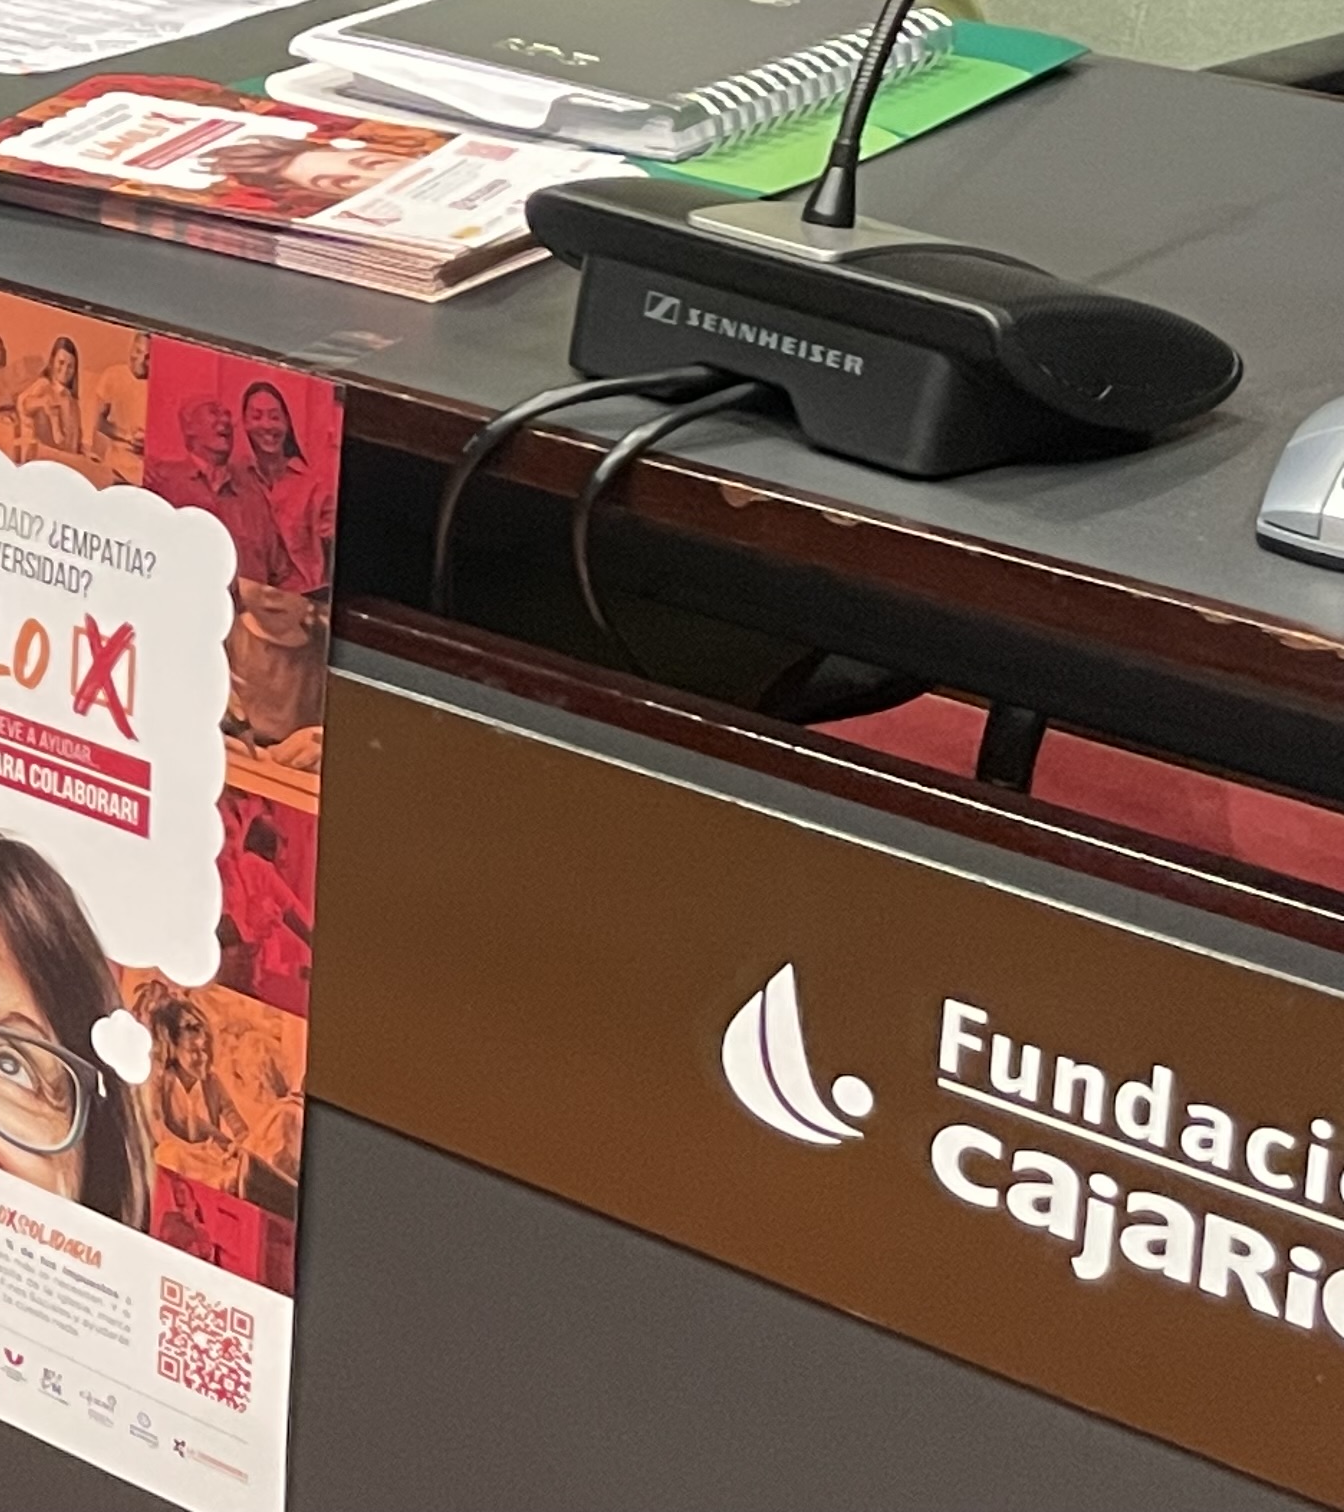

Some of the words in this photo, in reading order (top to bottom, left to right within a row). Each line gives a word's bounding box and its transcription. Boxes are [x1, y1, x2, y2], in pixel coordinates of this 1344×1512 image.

[686, 307, 863, 375] SENNHEISER
[48, 520, 157, 579] ¿EMPATÍA?
[26, 727, 37, 746] A
[29, 763, 139, 827] COLABORAR!
[938, 998, 1344, 1204] Fundaci
